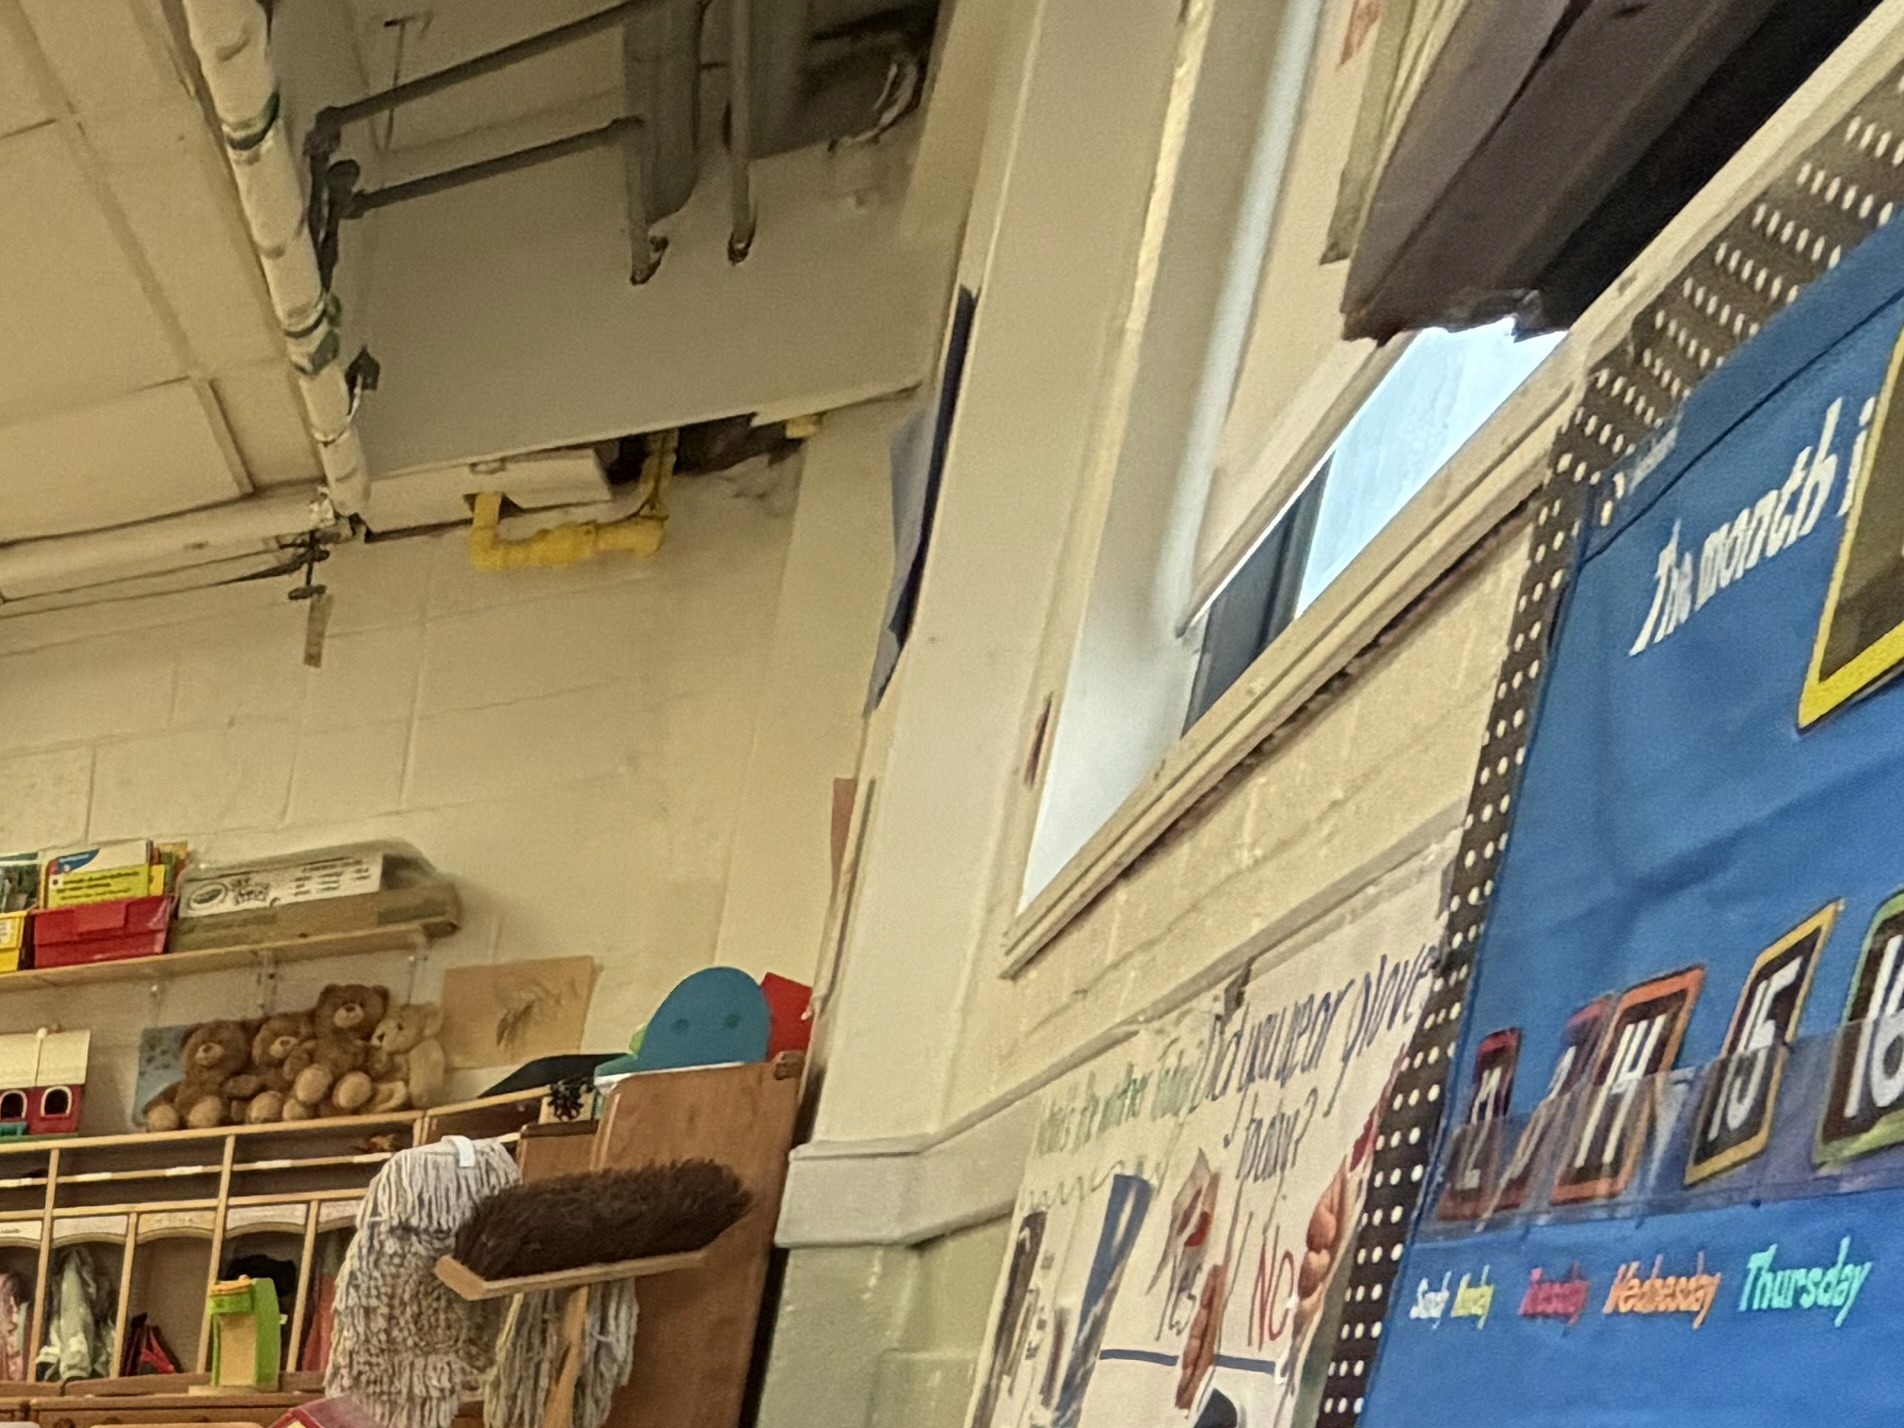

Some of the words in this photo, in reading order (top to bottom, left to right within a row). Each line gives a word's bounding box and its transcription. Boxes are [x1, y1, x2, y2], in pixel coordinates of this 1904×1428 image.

[1628, 517, 1692, 657] The
[1694, 397, 1838, 612] month
[1836, 397, 1875, 517] i
[1708, 956, 1803, 1142] 15
[1602, 1250, 1722, 1329] Wednesday
[1737, 1235, 1874, 1329] Thursday
